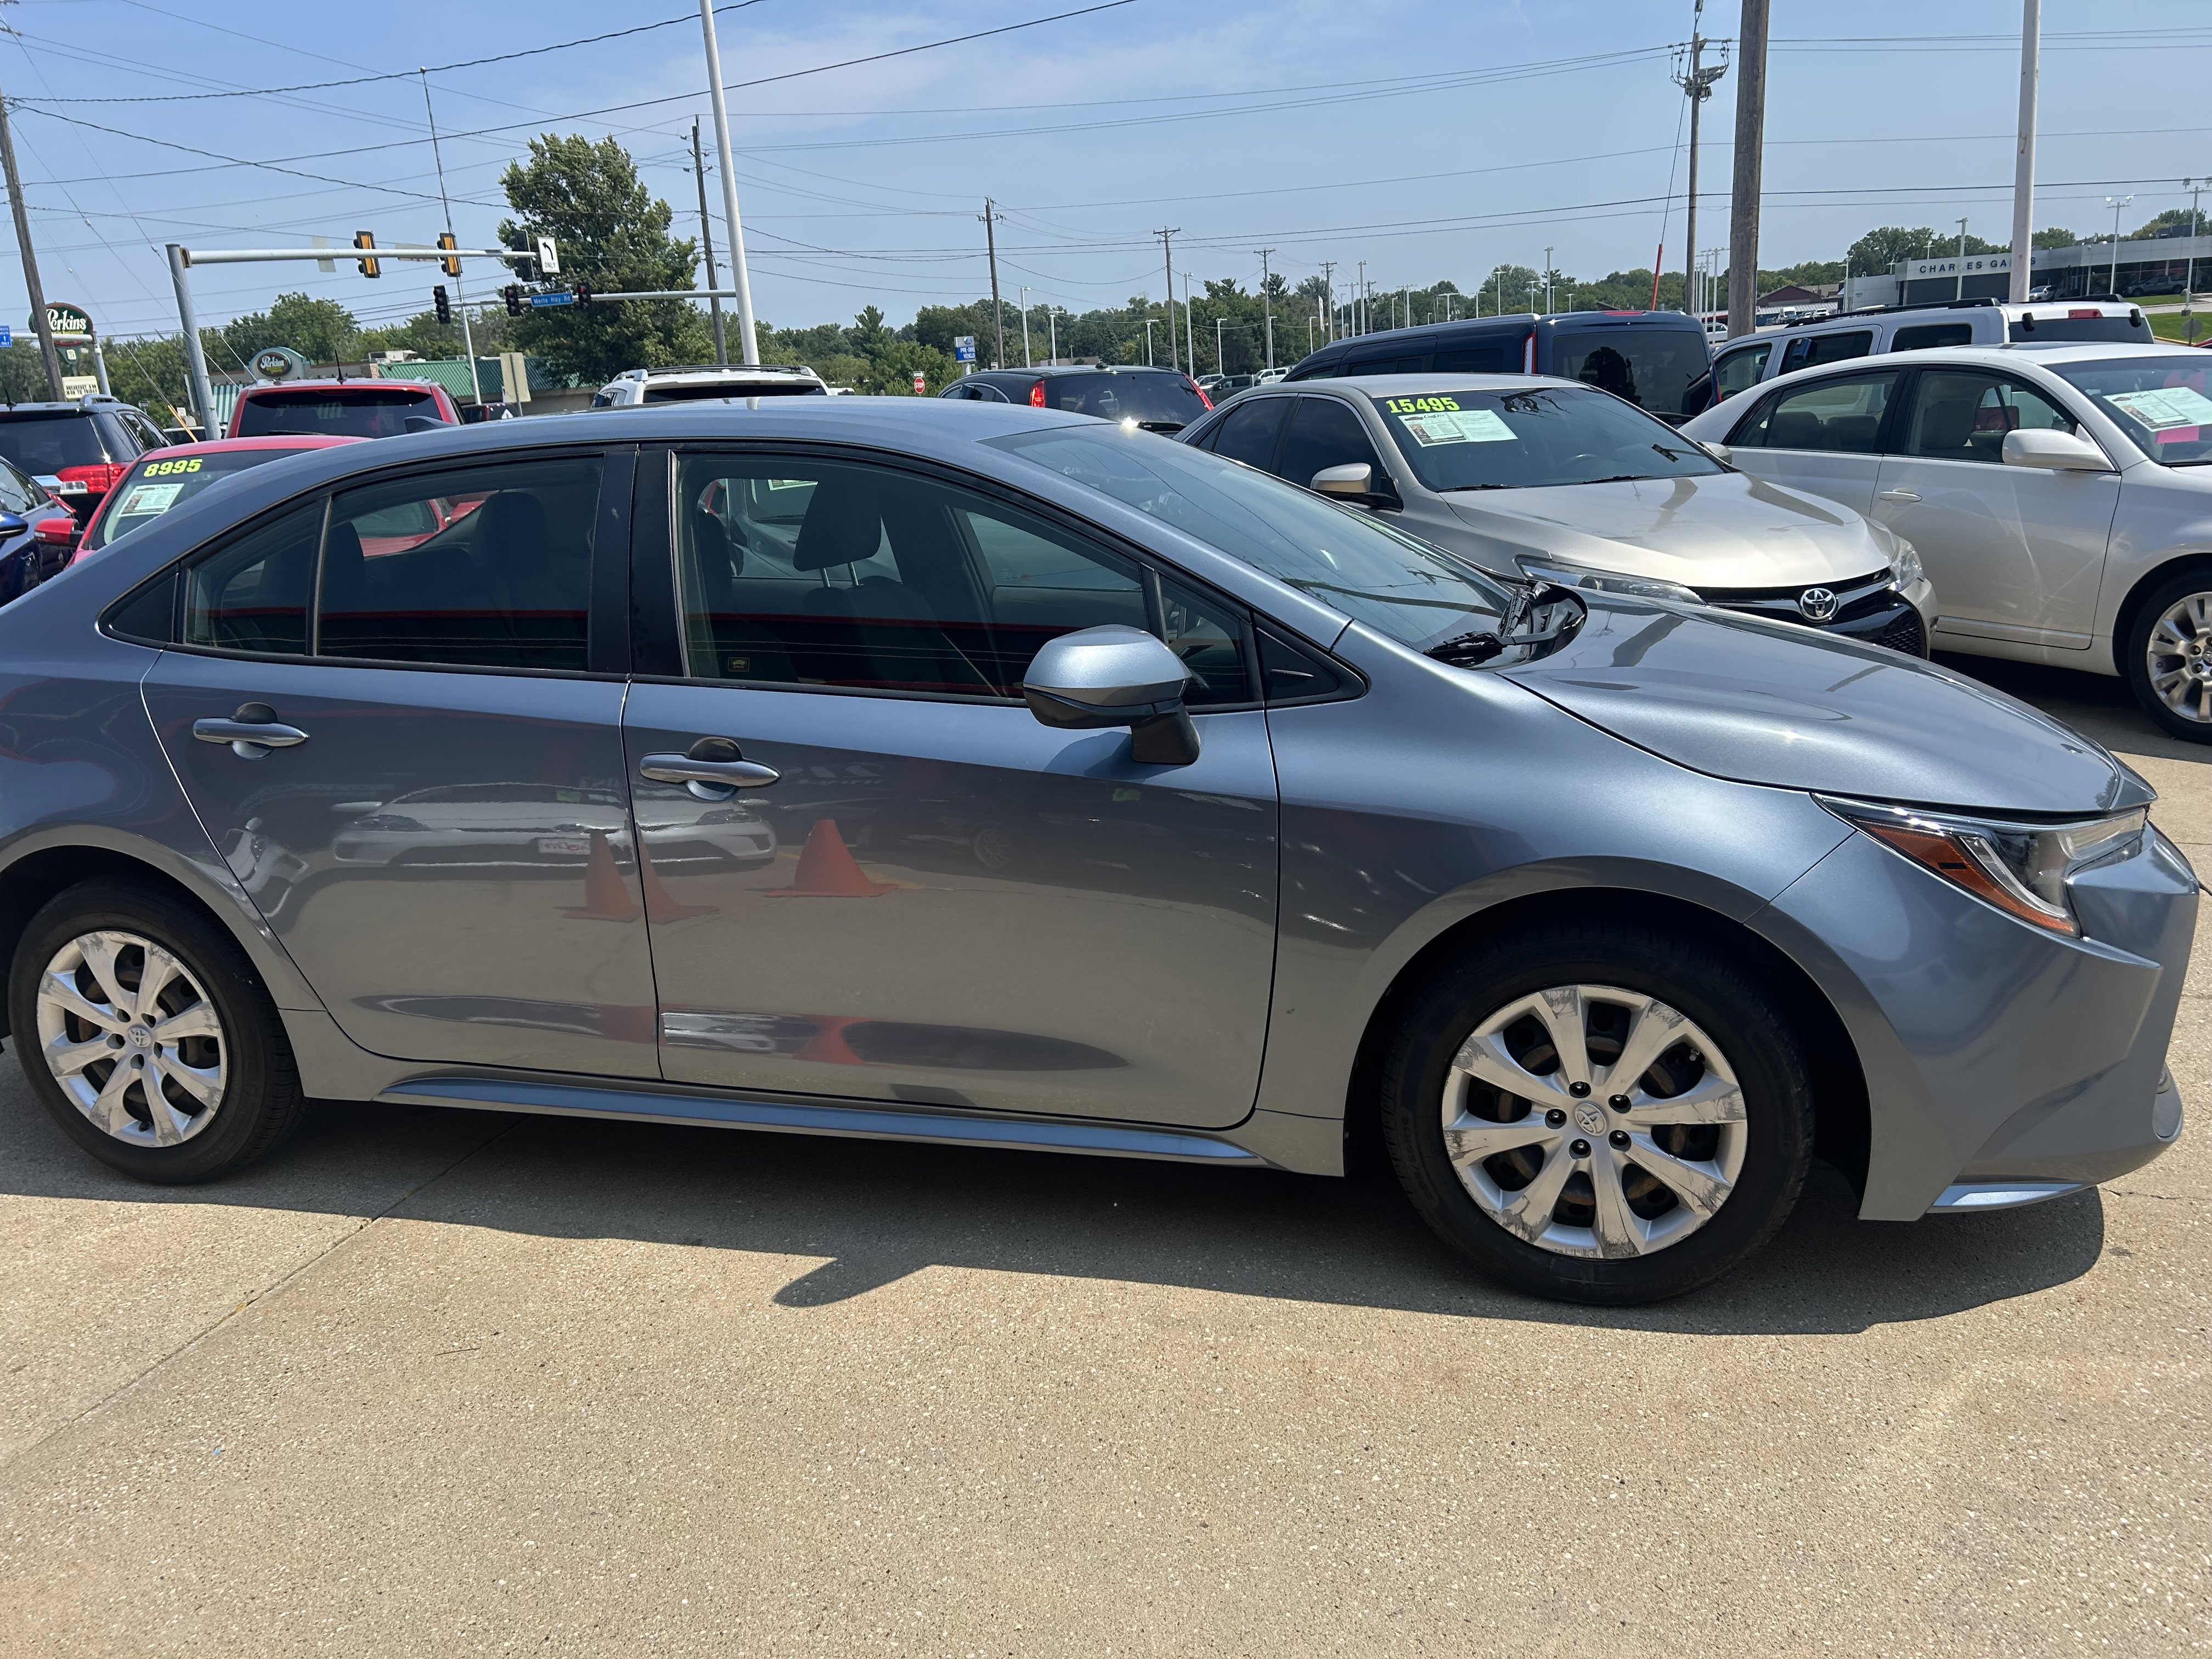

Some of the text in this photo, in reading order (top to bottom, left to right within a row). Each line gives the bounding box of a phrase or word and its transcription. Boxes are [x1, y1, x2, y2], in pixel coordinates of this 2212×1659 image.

[1920, 257, 2036, 273] CHARES GAS
[46, 309, 86, 330] Perkins
[1386, 397, 1460, 413] 15495
[144, 459, 203, 477] 8995
